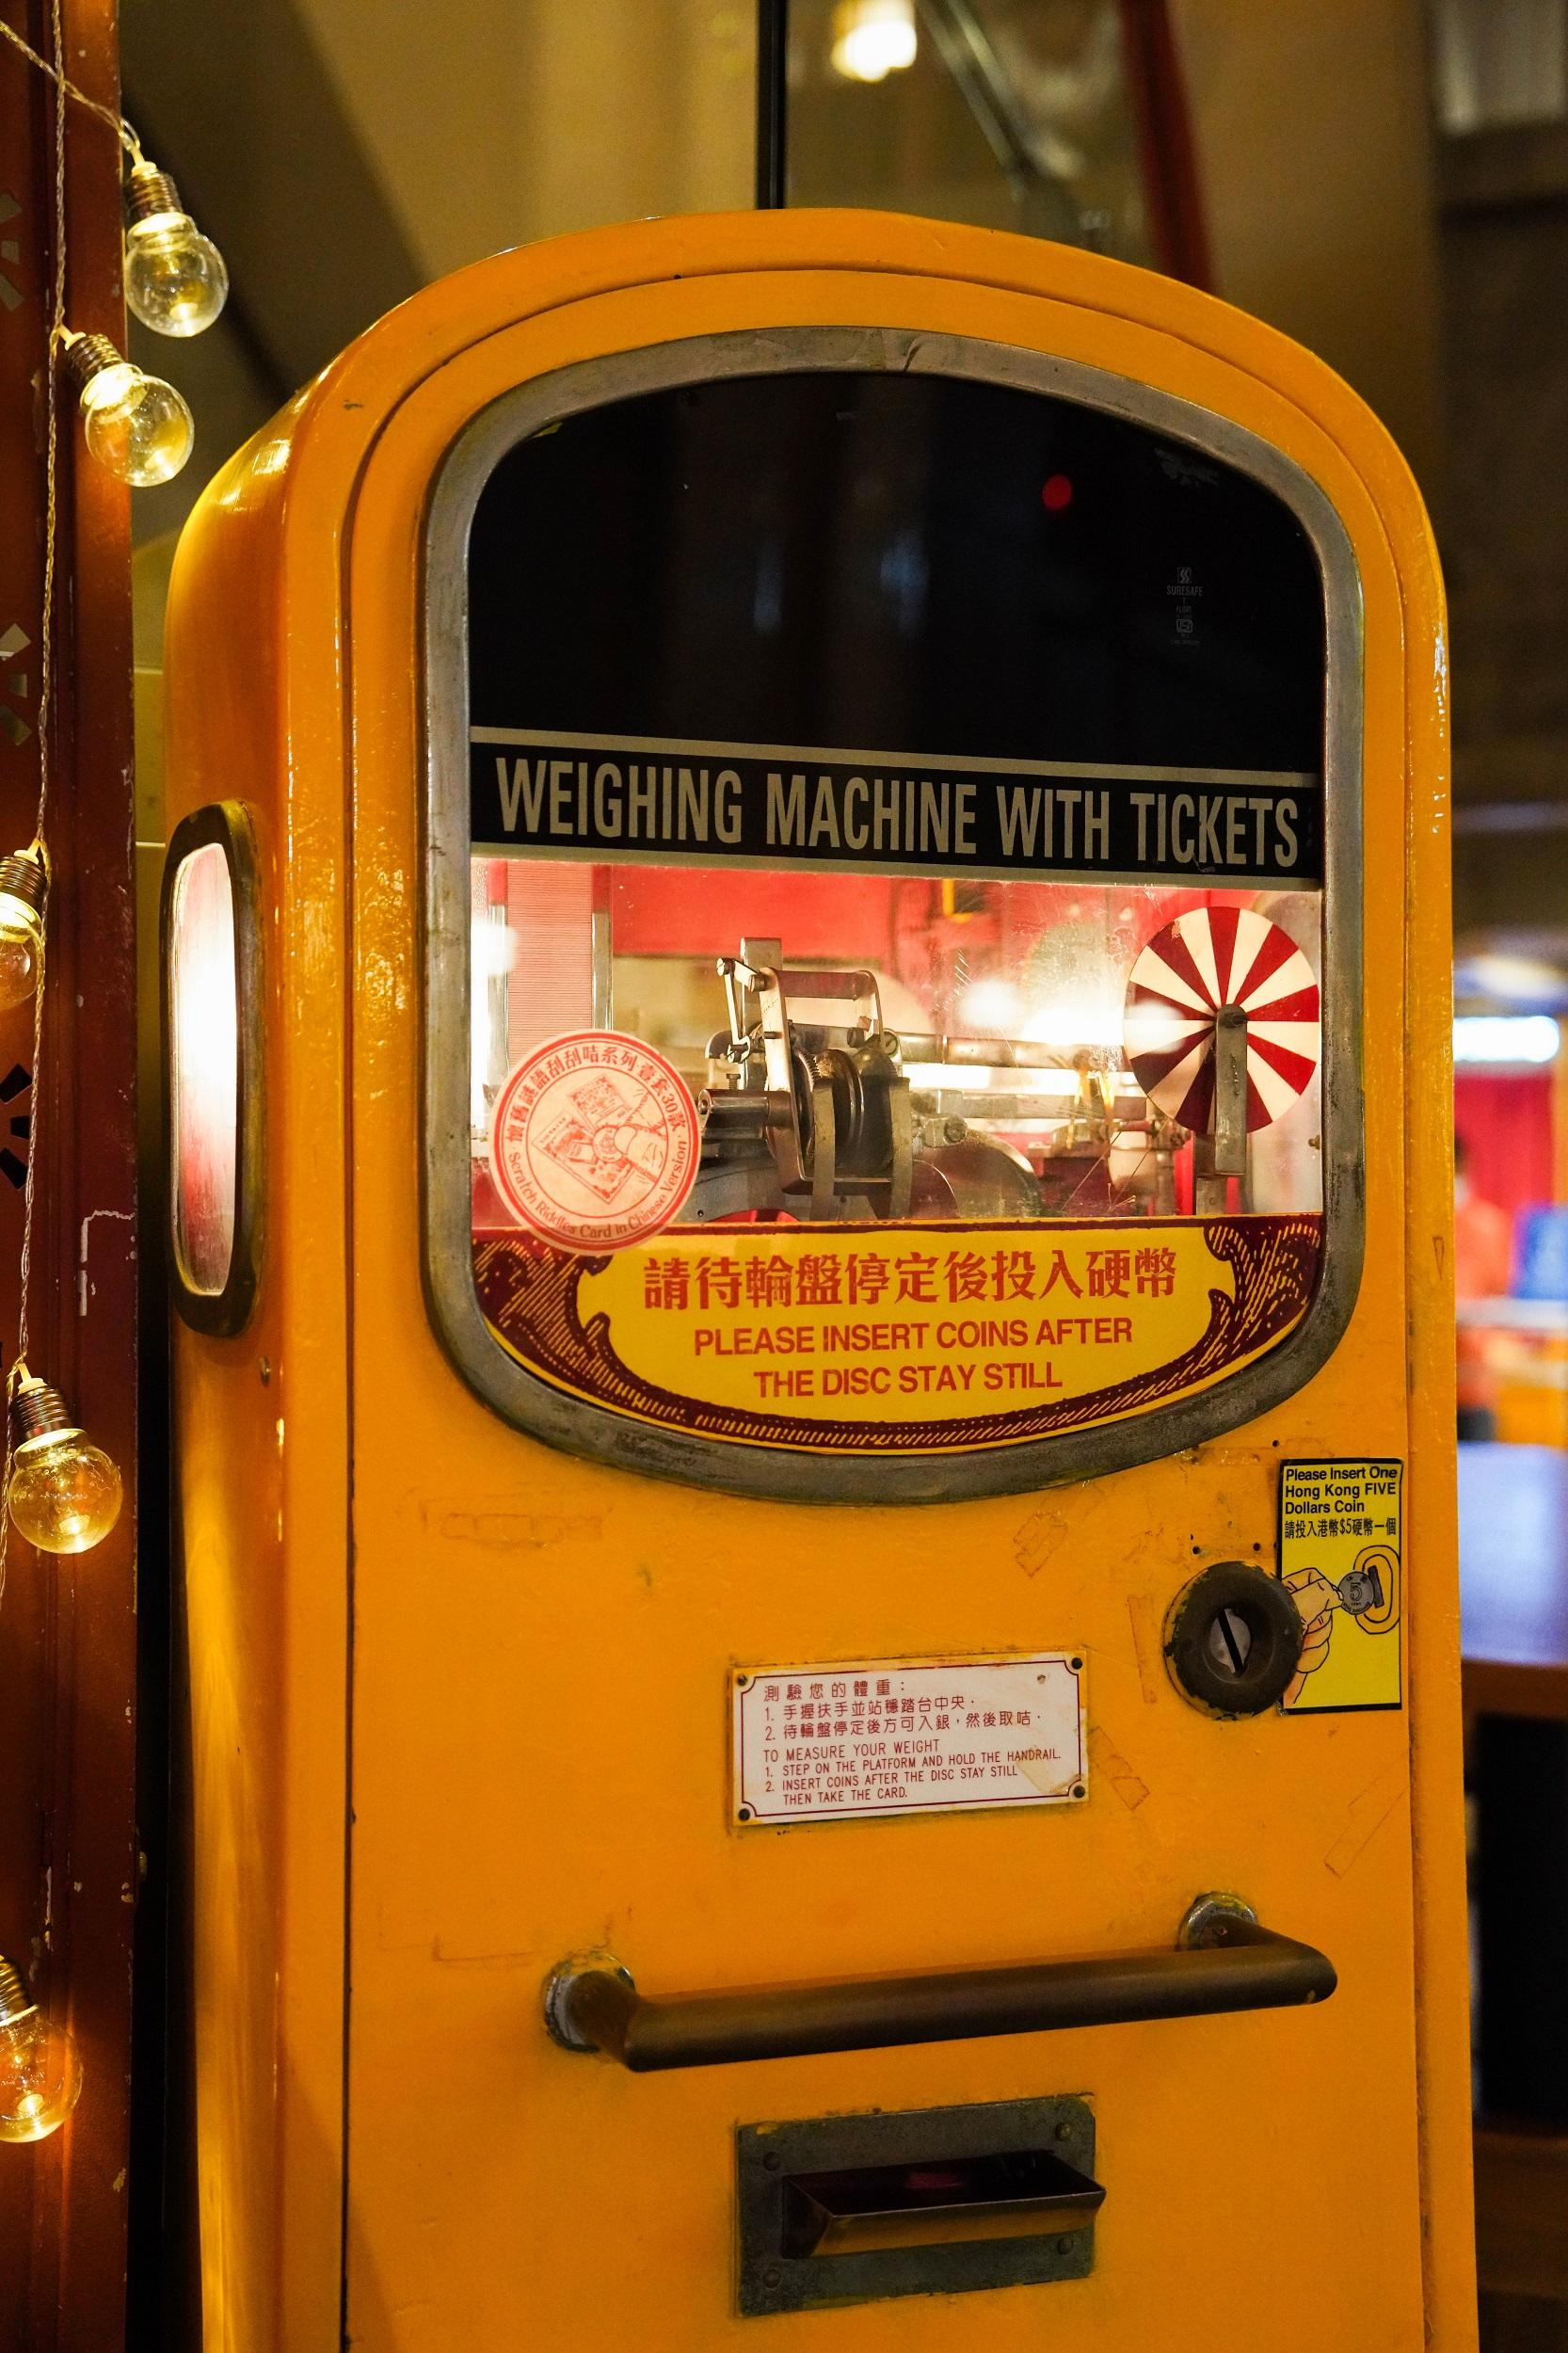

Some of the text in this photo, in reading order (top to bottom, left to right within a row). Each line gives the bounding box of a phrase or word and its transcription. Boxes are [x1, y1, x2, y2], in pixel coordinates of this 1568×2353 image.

[1166, 585, 1204, 597] SURESAFE
[495, 757, 1299, 868] WEIGHING MACHINE WITH TICKETS
[508, 1140, 688, 1239] Scratch Riddles Card in Chinese Version
[644, 1247, 1176, 1310] 請待輪盤停定後投入硬幣
[695, 1318, 1132, 1355] PLEASE INSERT COINS AFTER
[753, 1362, 1062, 1398] THE DISC STAY STILL
[1287, 1466, 1397, 1481] Please Insert One
[1286, 1482, 1396, 1499] Hong Kong FIVE
[1286, 1500, 1365, 1514] Dollars Coin
[1285, 1517, 1396, 1539] 請投入港幣$5硬幣一個
[1350, 1582, 1362, 1601] 5
[765, 1708, 774, 1721] 1.
[765, 1726, 776, 1741] 2.
[763, 1740, 939, 1763] TO MEASURE YOUR WEIGHT
[765, 1749, 1061, 1777] 1. STEP ON THE PLATFORM AND HOLD THE HANDRAIL.
[765, 1765, 1017, 1792] 2. INSERT COINS AFTER THE DISC STAY STILL
[784, 1786, 907, 1805] THEN TAKE THE CARD.
